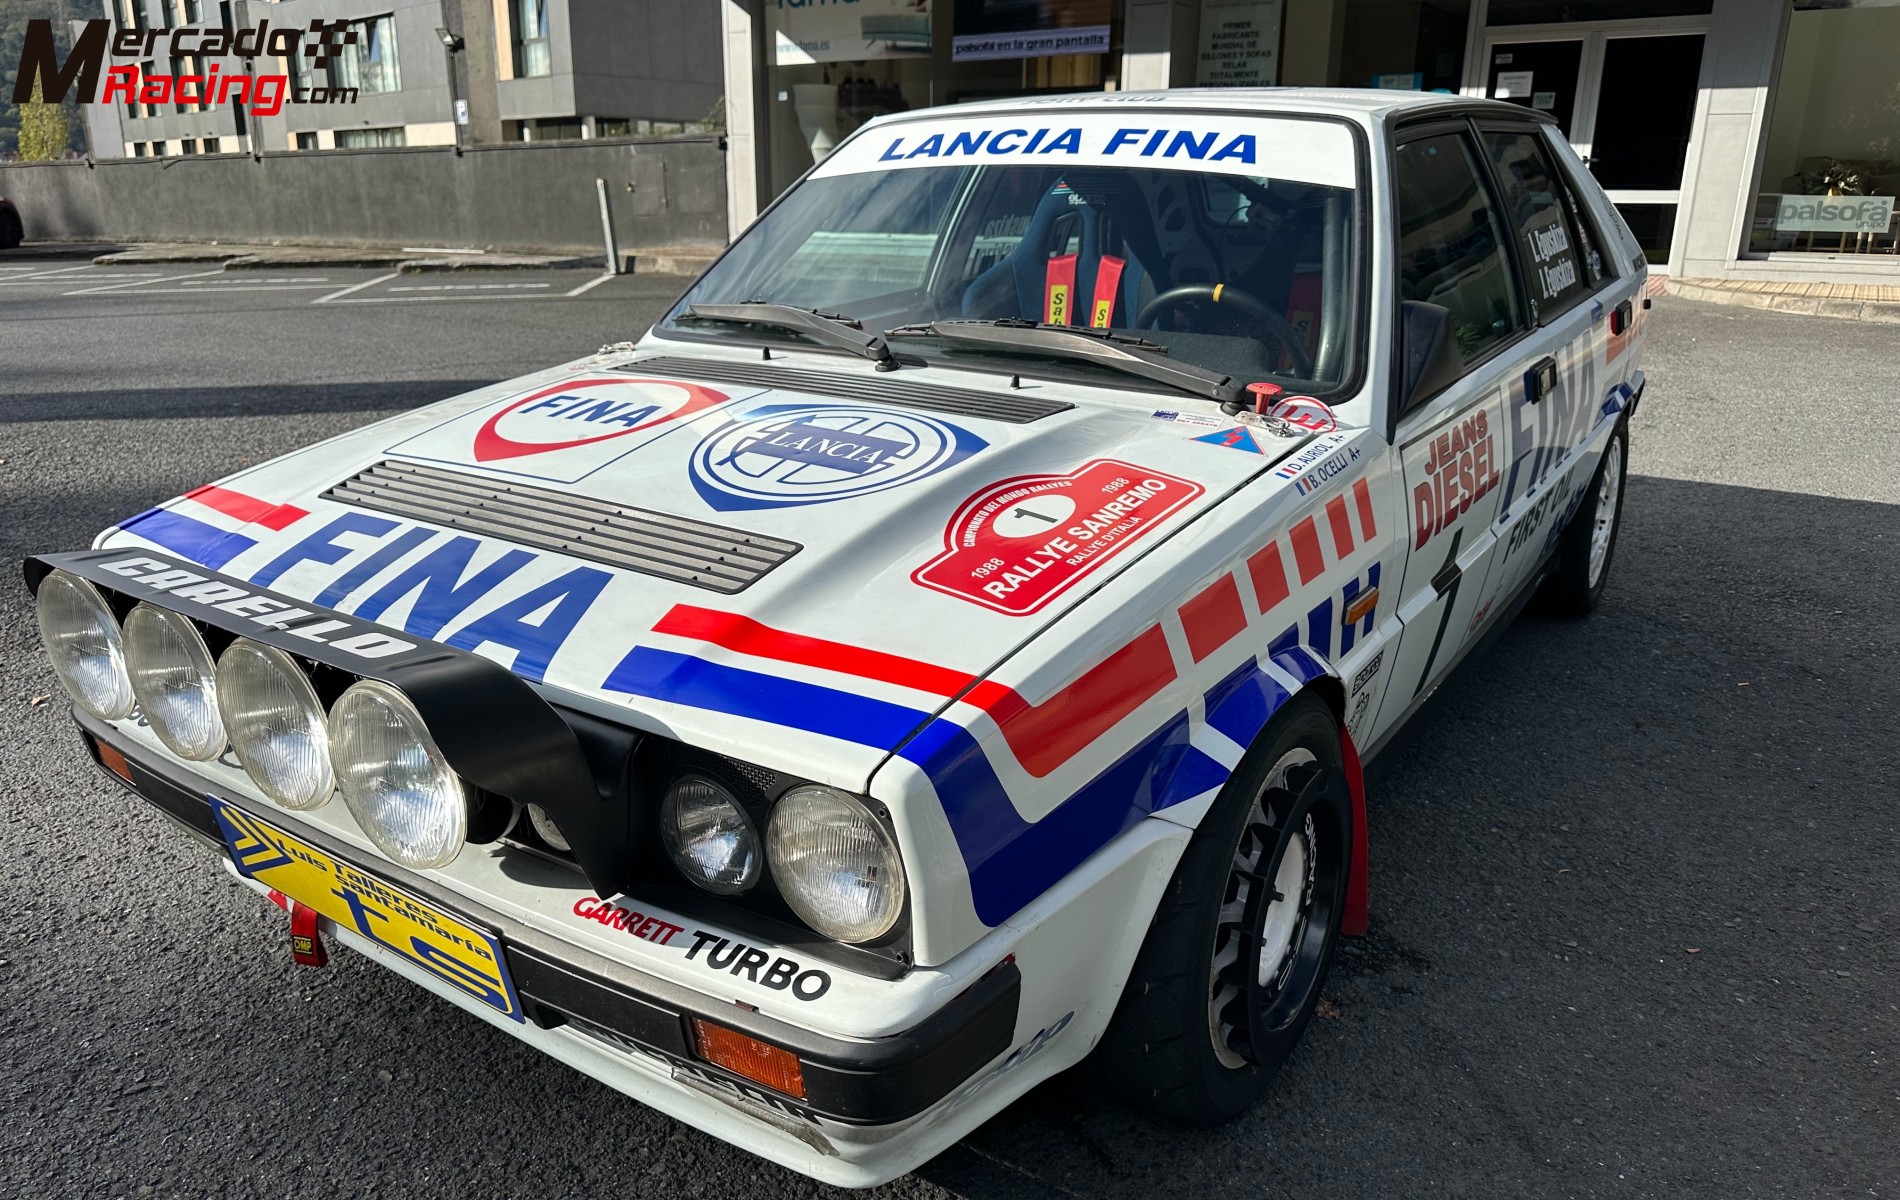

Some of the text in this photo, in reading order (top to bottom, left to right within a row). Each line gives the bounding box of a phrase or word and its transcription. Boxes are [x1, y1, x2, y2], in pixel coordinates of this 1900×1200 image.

[998, 41, 1011, 51] en
[1013, 39, 1025, 50] la
[1027, 39, 1053, 51] gran
[1056, 34, 1104, 49] pantalla
[1212, 31, 1260, 40] FABRICANTE
[1222, 21, 1252, 29] PRIMER
[1201, 51, 1237, 61] SILLONES
[1211, 42, 1245, 50] MUNDIAL
[1222, 61, 1247, 69] RELAX
[1210, 71, 1260, 79] TOTALMENTE
[878, 127, 1258, 165] LANCIA FINA
[1856, 221, 1886, 229] grupo
[519, 395, 660, 429] FINA
[1499, 328, 1598, 524] FINA
[767, 429, 881, 466] LANCIA
[1334, 434, 1346, 444] A+
[1425, 409, 1488, 476] JEANS
[1309, 447, 1361, 490] B. OCELLI A+
[1413, 434, 1500, 552] DIESEL
[963, 481, 1072, 547] CAMPIONATO DEL MONDO RALLYES
[971, 477, 1130, 580] 1988 1988
[1014, 507, 1058, 523] 1
[1502, 491, 1551, 565] FIRST
[983, 479, 1167, 600] RALLYE SANREMO
[1066, 516, 1142, 567] RALLYE D'ITALIA
[98, 556, 418, 659] CARELLO
[248, 511, 615, 686] FINA
[277, 838, 438, 924] Luis Talleres
[294, 939, 312, 951] OMP
[573, 896, 832, 1002] GARRETT TURBO
